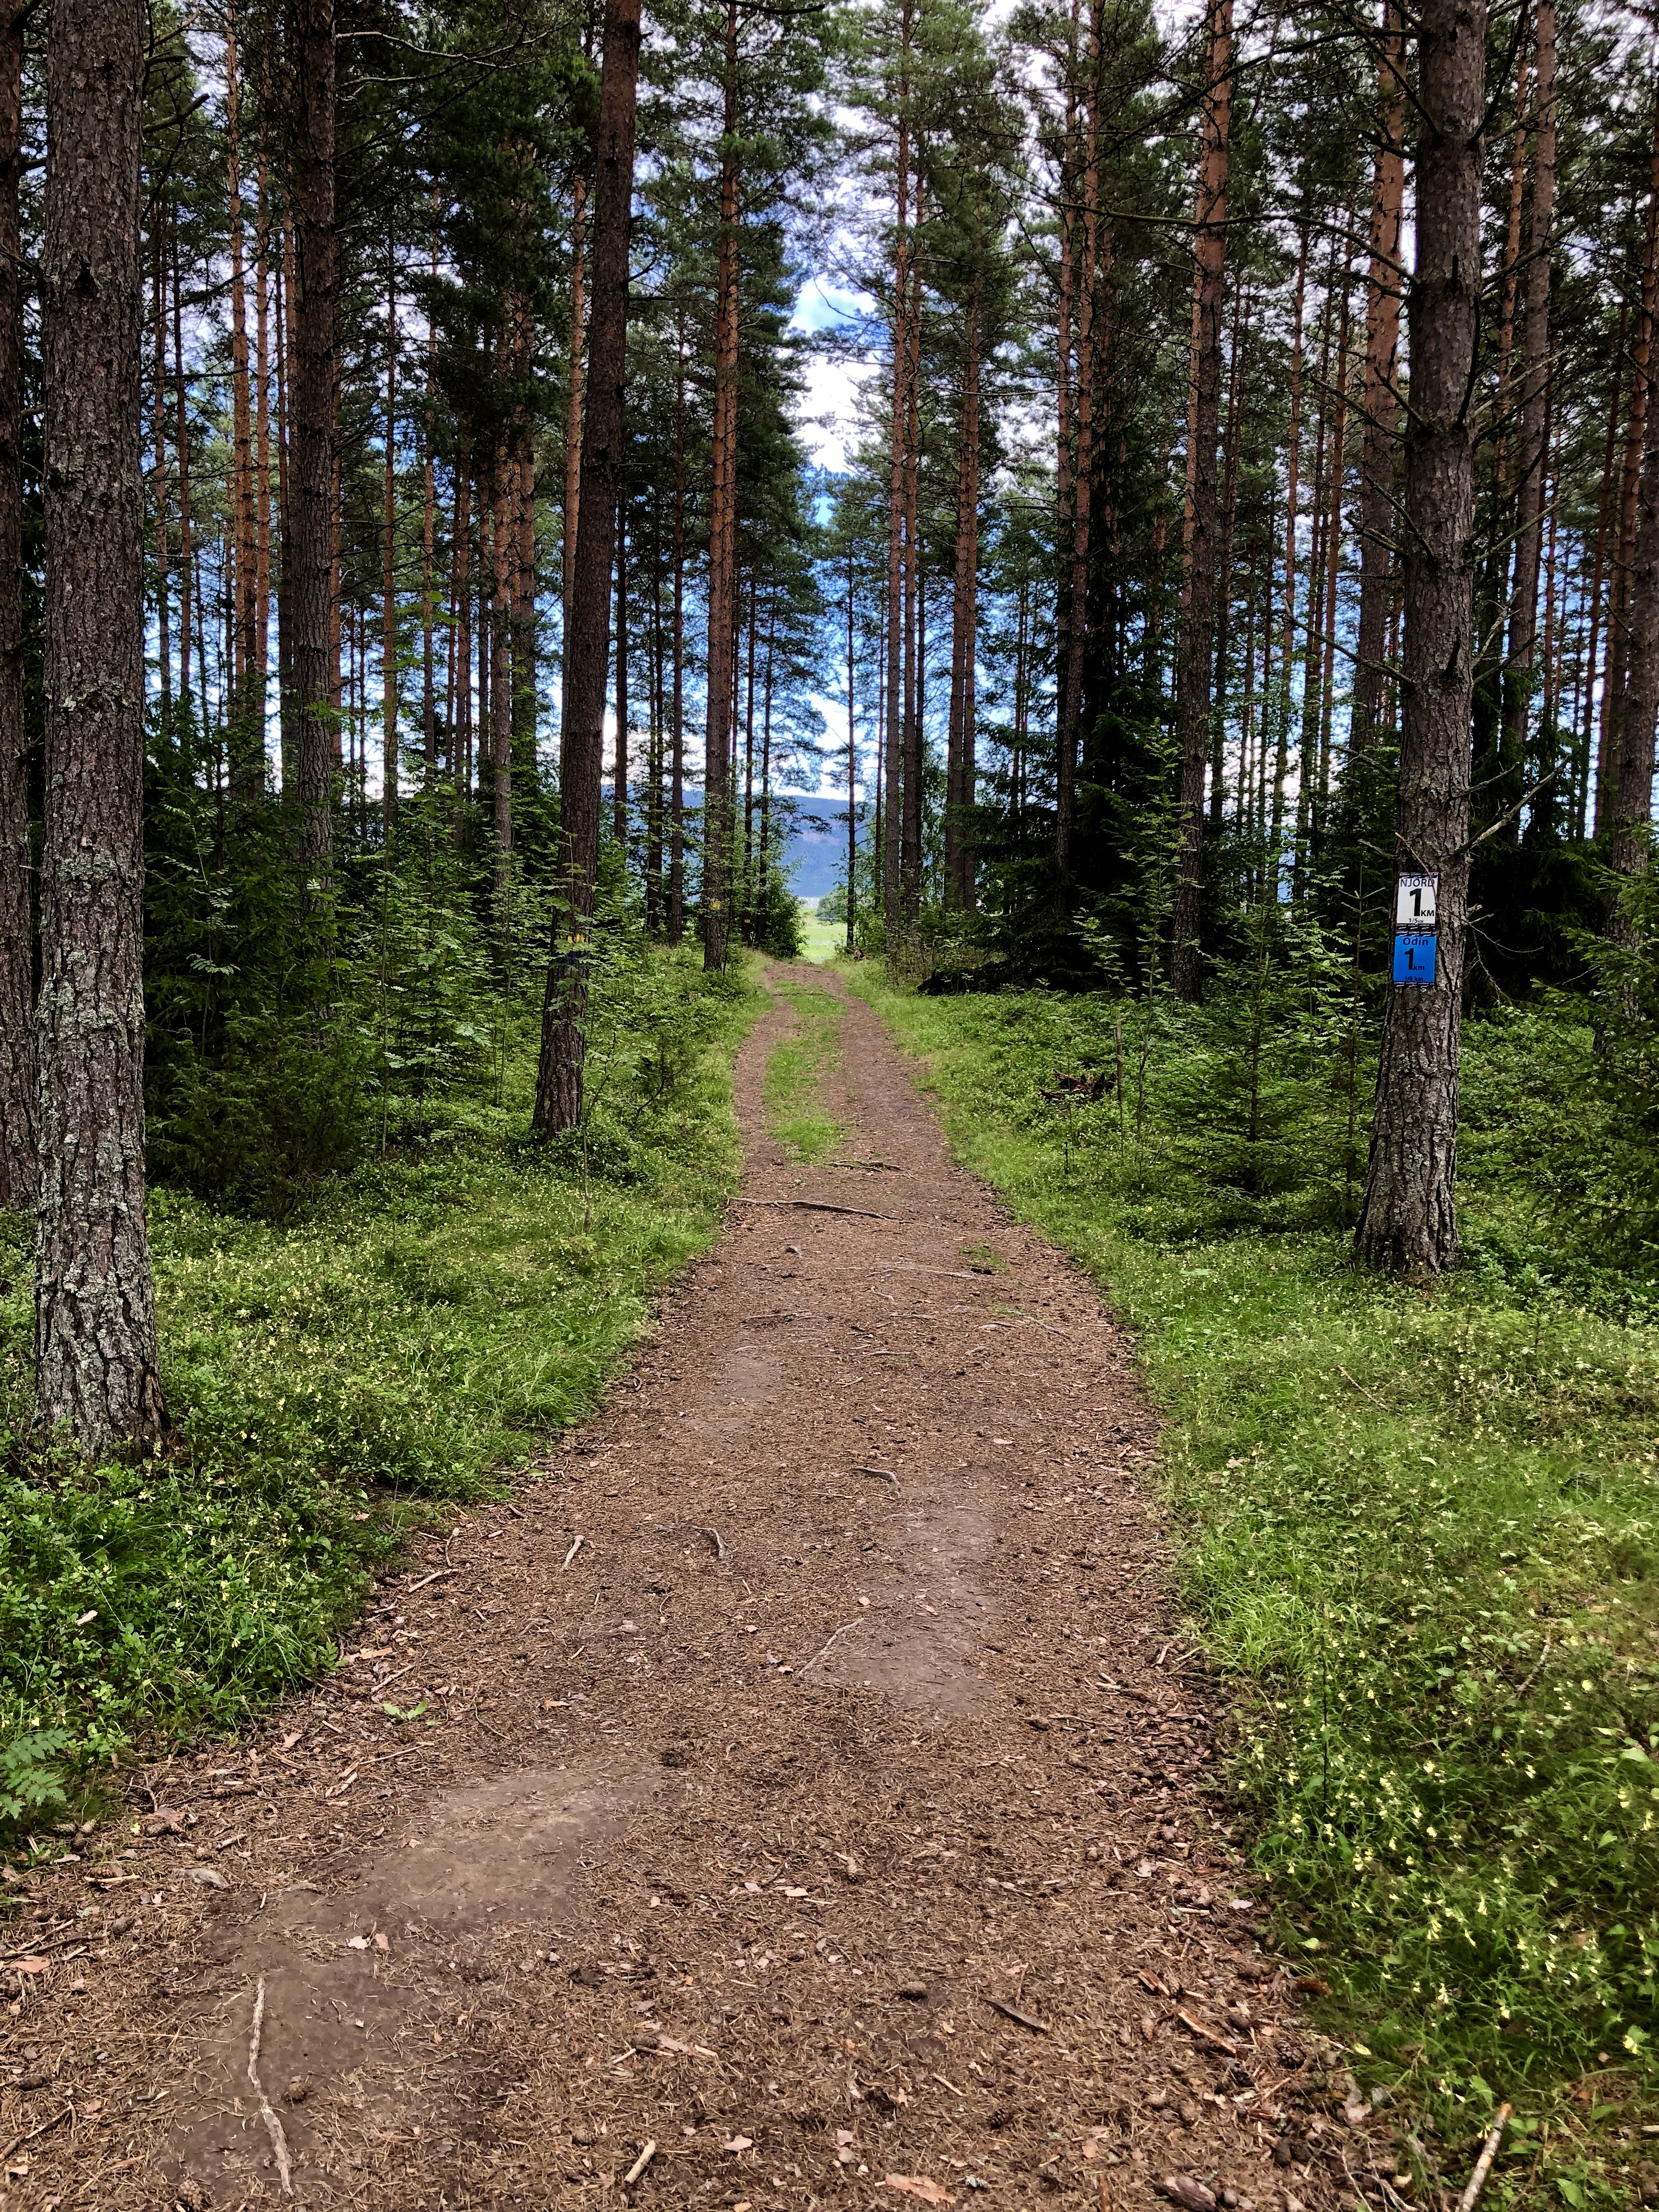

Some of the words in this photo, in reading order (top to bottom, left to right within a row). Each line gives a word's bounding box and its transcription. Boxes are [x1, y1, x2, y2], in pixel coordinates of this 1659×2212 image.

[1401, 879, 1435, 887] NJORD
[1409, 888, 1421, 917] 1
[1403, 937, 1429, 945] Odin
[1404, 947, 1414, 970] 1
